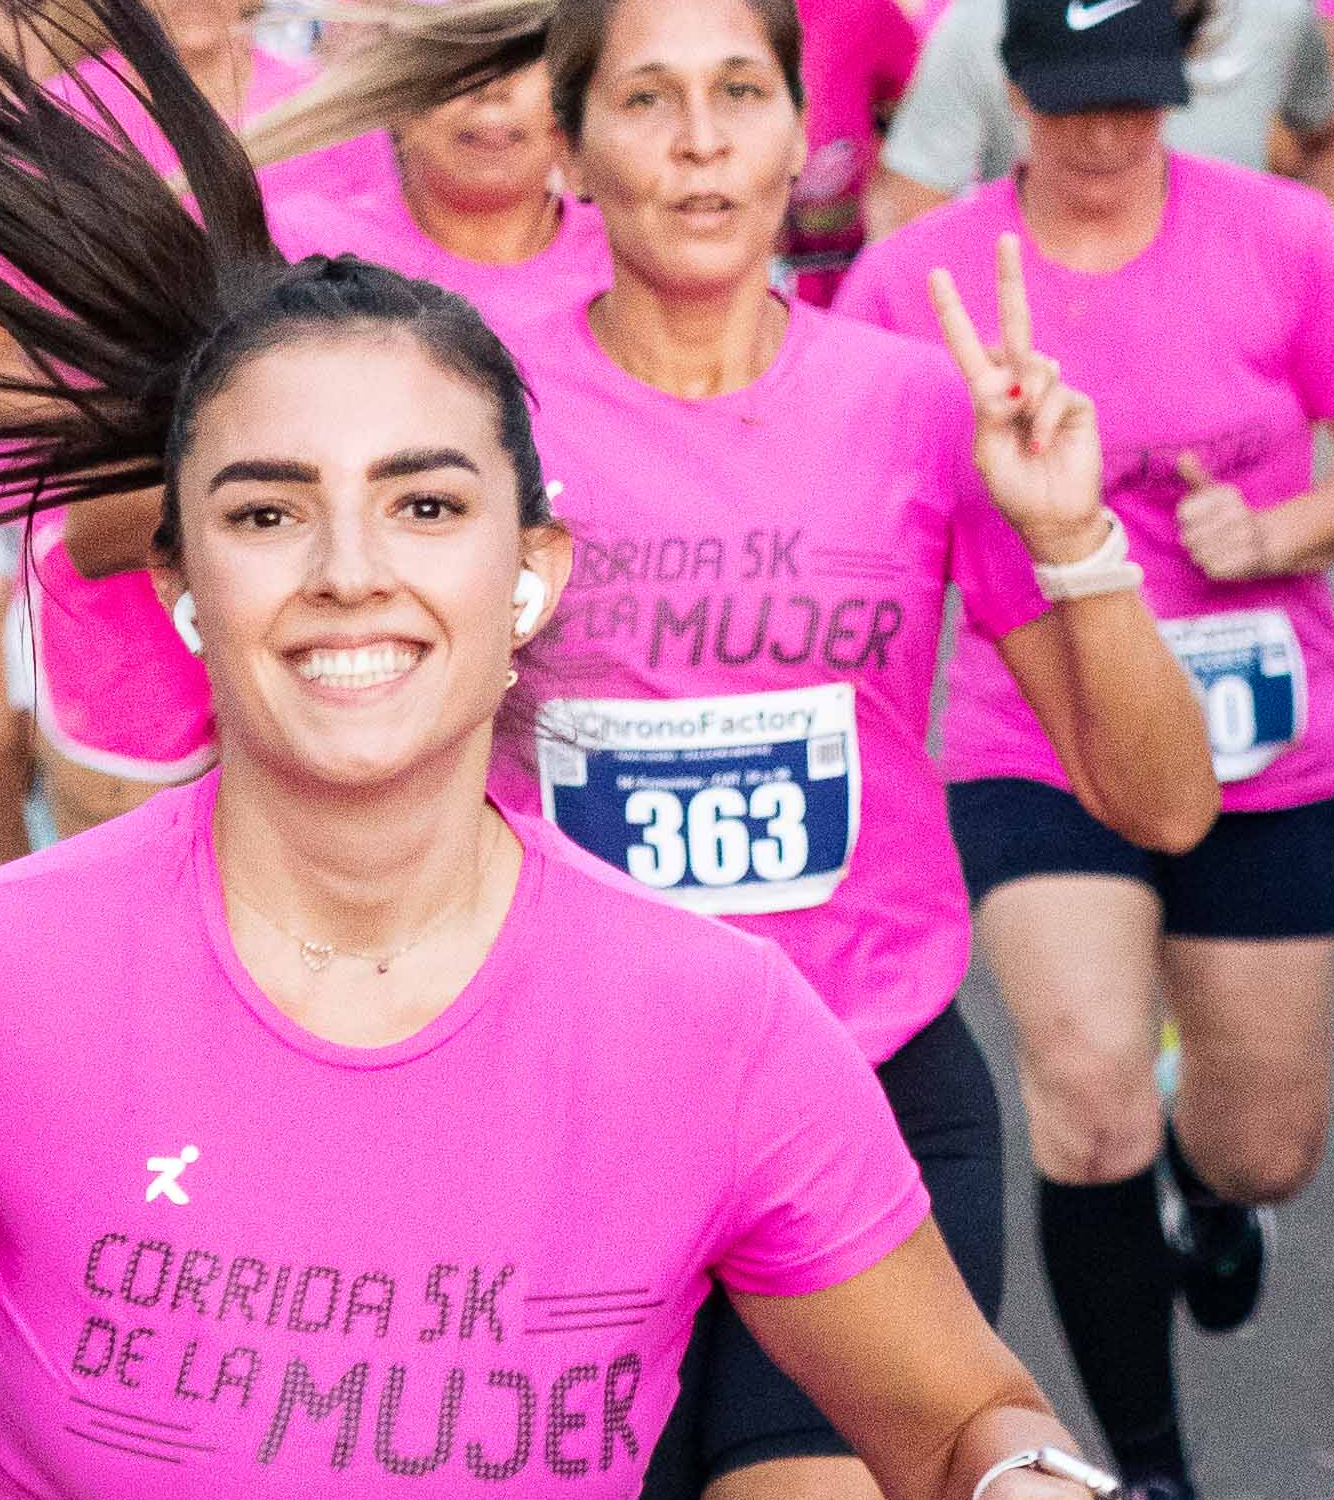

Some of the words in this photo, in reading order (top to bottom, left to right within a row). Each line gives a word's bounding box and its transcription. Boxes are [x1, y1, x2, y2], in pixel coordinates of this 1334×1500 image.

[648, 594, 903, 670] MUJER
[579, 708, 818, 740] ChronoFactory
[625, 780, 809, 888] 363
[84, 1233, 396, 1340] CORRIDA
[419, 1262, 515, 1343] 5K
[70, 1316, 155, 1389] DE
[174, 1340, 262, 1409] LA
[257, 1352, 643, 1480] MUJER
